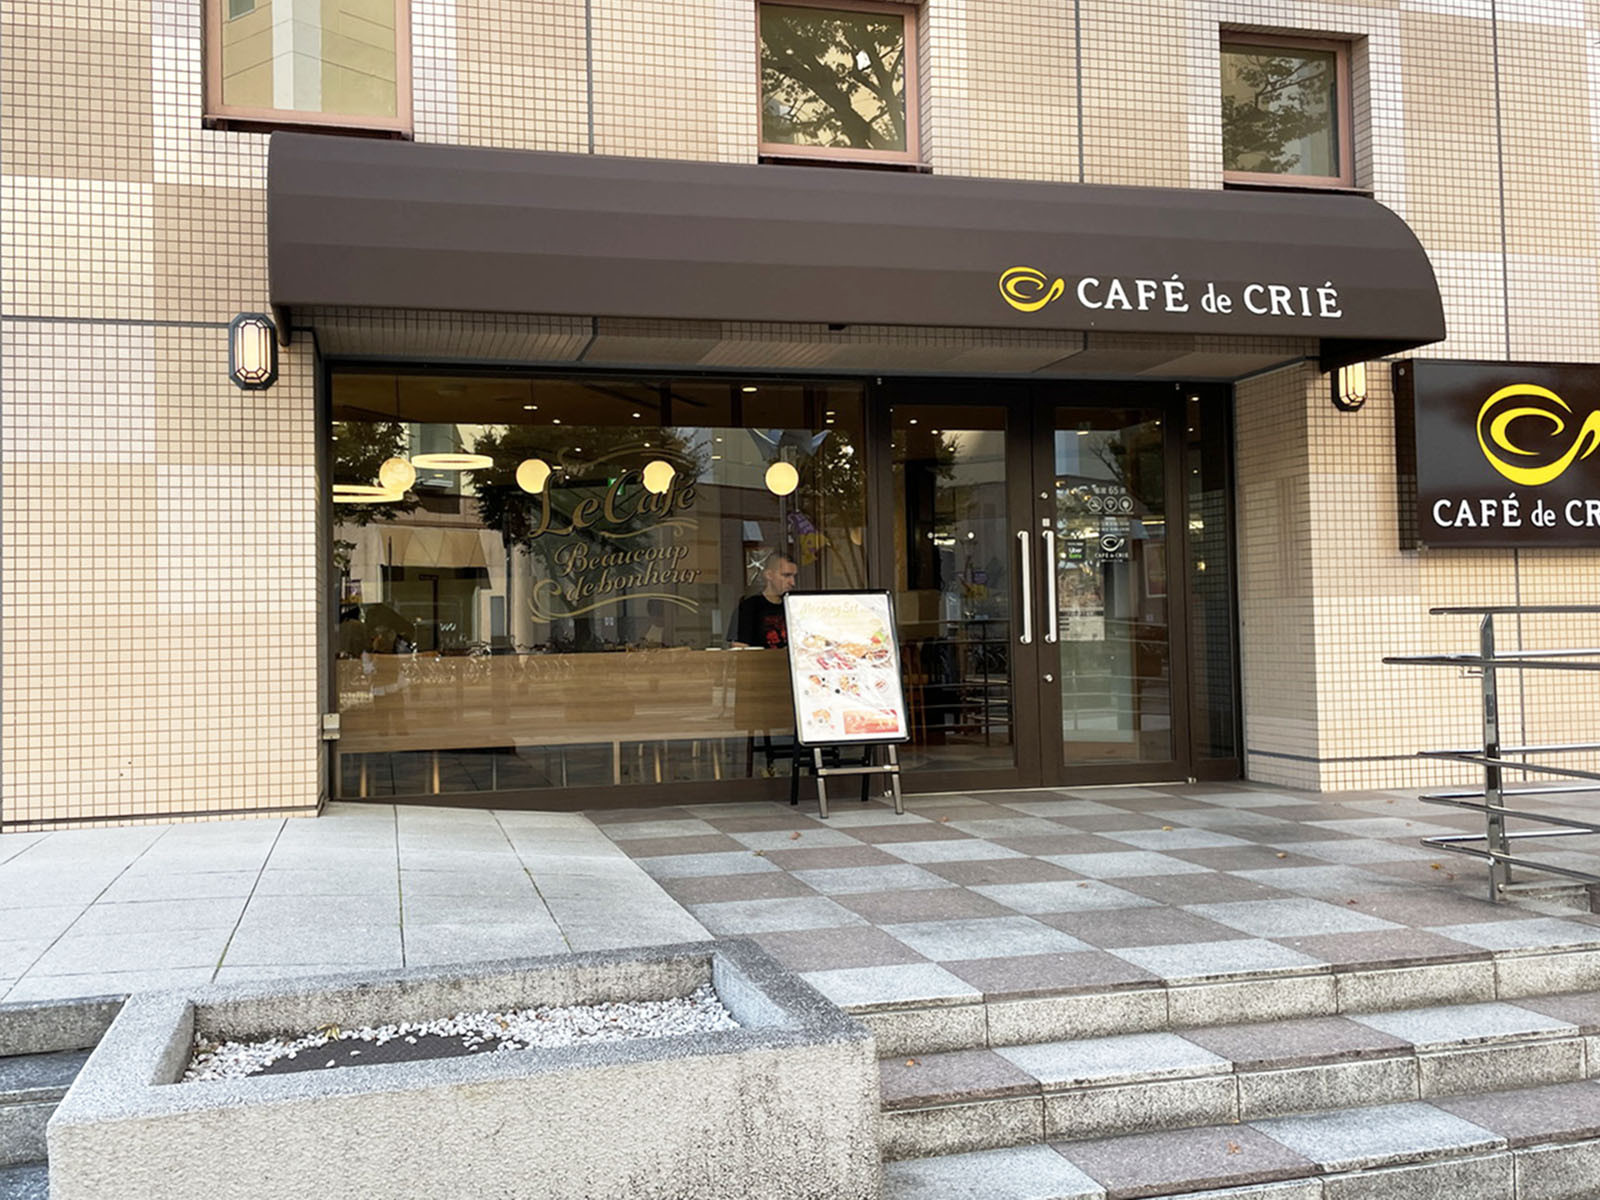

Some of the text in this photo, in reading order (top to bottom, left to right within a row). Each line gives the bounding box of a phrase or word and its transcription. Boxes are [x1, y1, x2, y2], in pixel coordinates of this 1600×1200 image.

[1077, 273, 1342, 319] CAFÉ de CRIÉ
[1432, 491, 1522, 528] CAFÉ
[1530, 498, 1557, 528] de
[554, 541, 689, 577] Beaucoup
